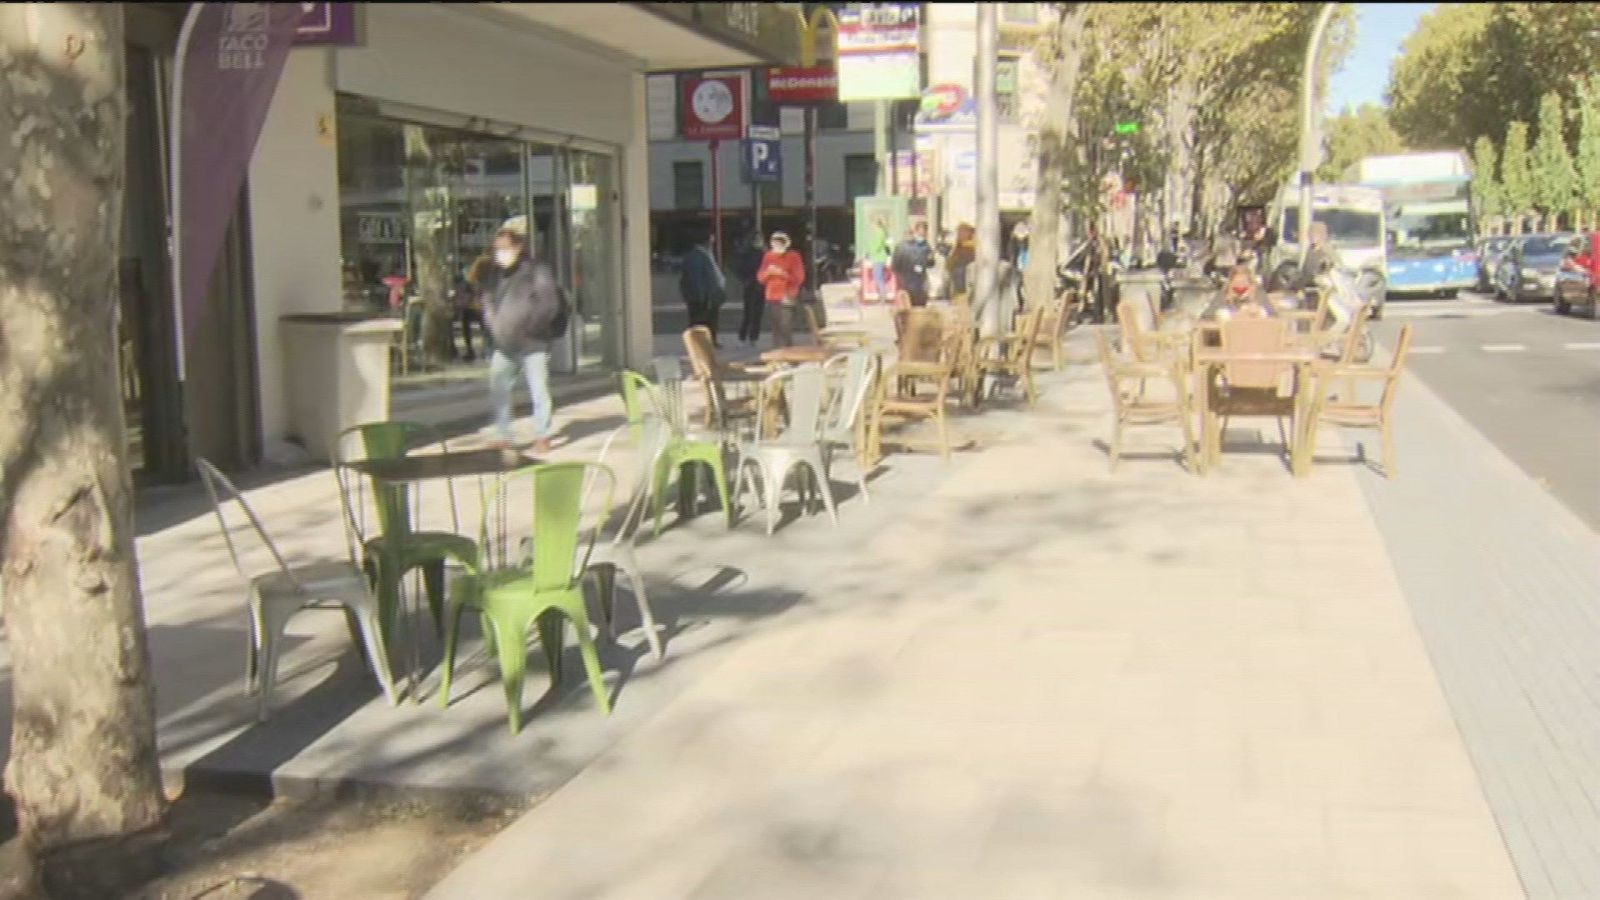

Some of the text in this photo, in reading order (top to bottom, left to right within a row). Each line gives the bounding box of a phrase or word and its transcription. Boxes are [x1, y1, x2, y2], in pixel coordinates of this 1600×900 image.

[218, 34, 268, 51] TACO
[218, 51, 265, 69] BELL
[752, 142, 769, 169] P
